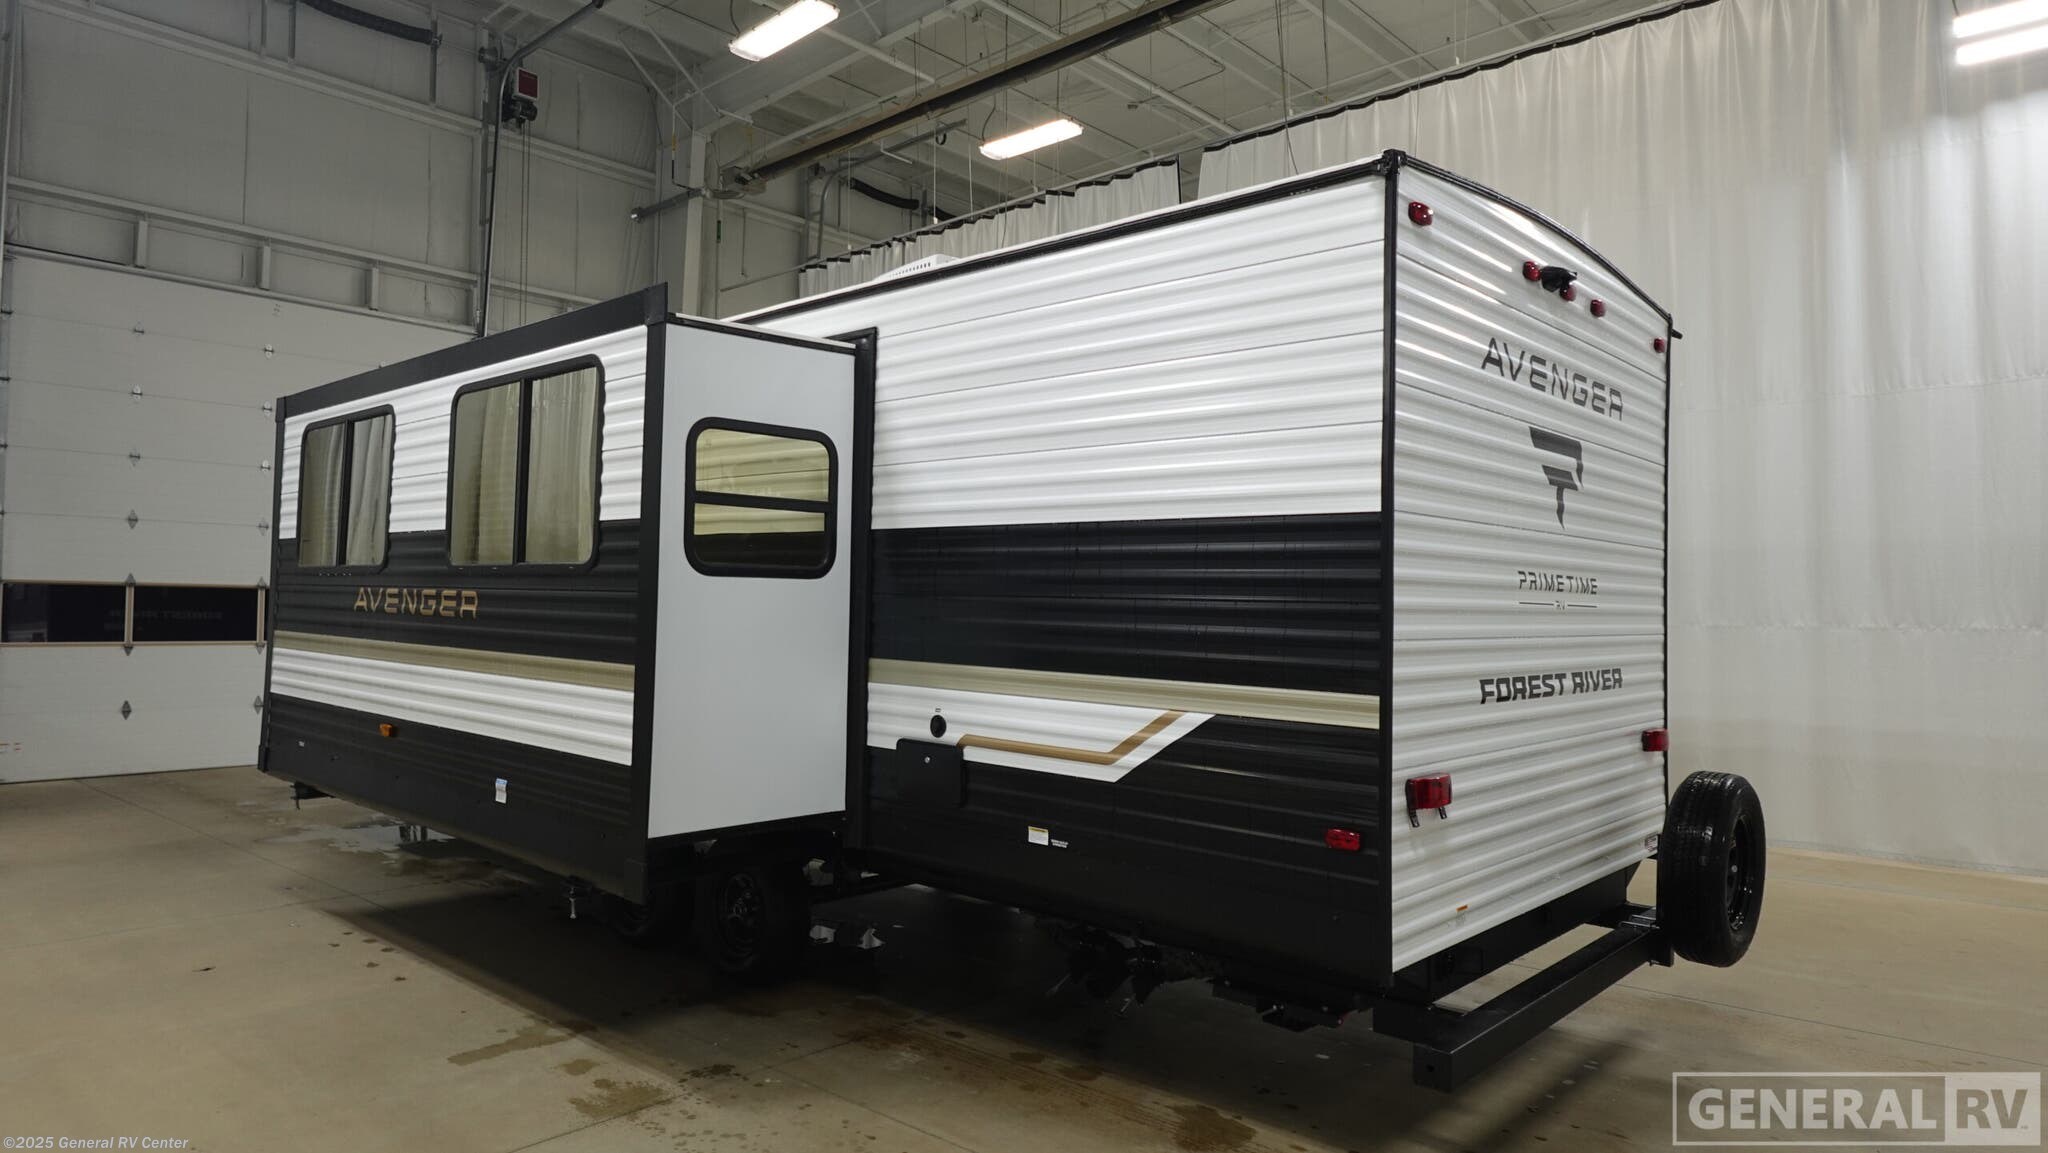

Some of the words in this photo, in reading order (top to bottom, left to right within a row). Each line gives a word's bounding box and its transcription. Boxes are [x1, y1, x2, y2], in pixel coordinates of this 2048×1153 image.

[1481, 337, 1623, 421] AVENGER
[1518, 571, 1598, 595] PRIMETIME
[354, 587, 478, 619] AVENGER
[1480, 673, 1567, 704] FOREST
[1571, 668, 1623, 694] RIVER
